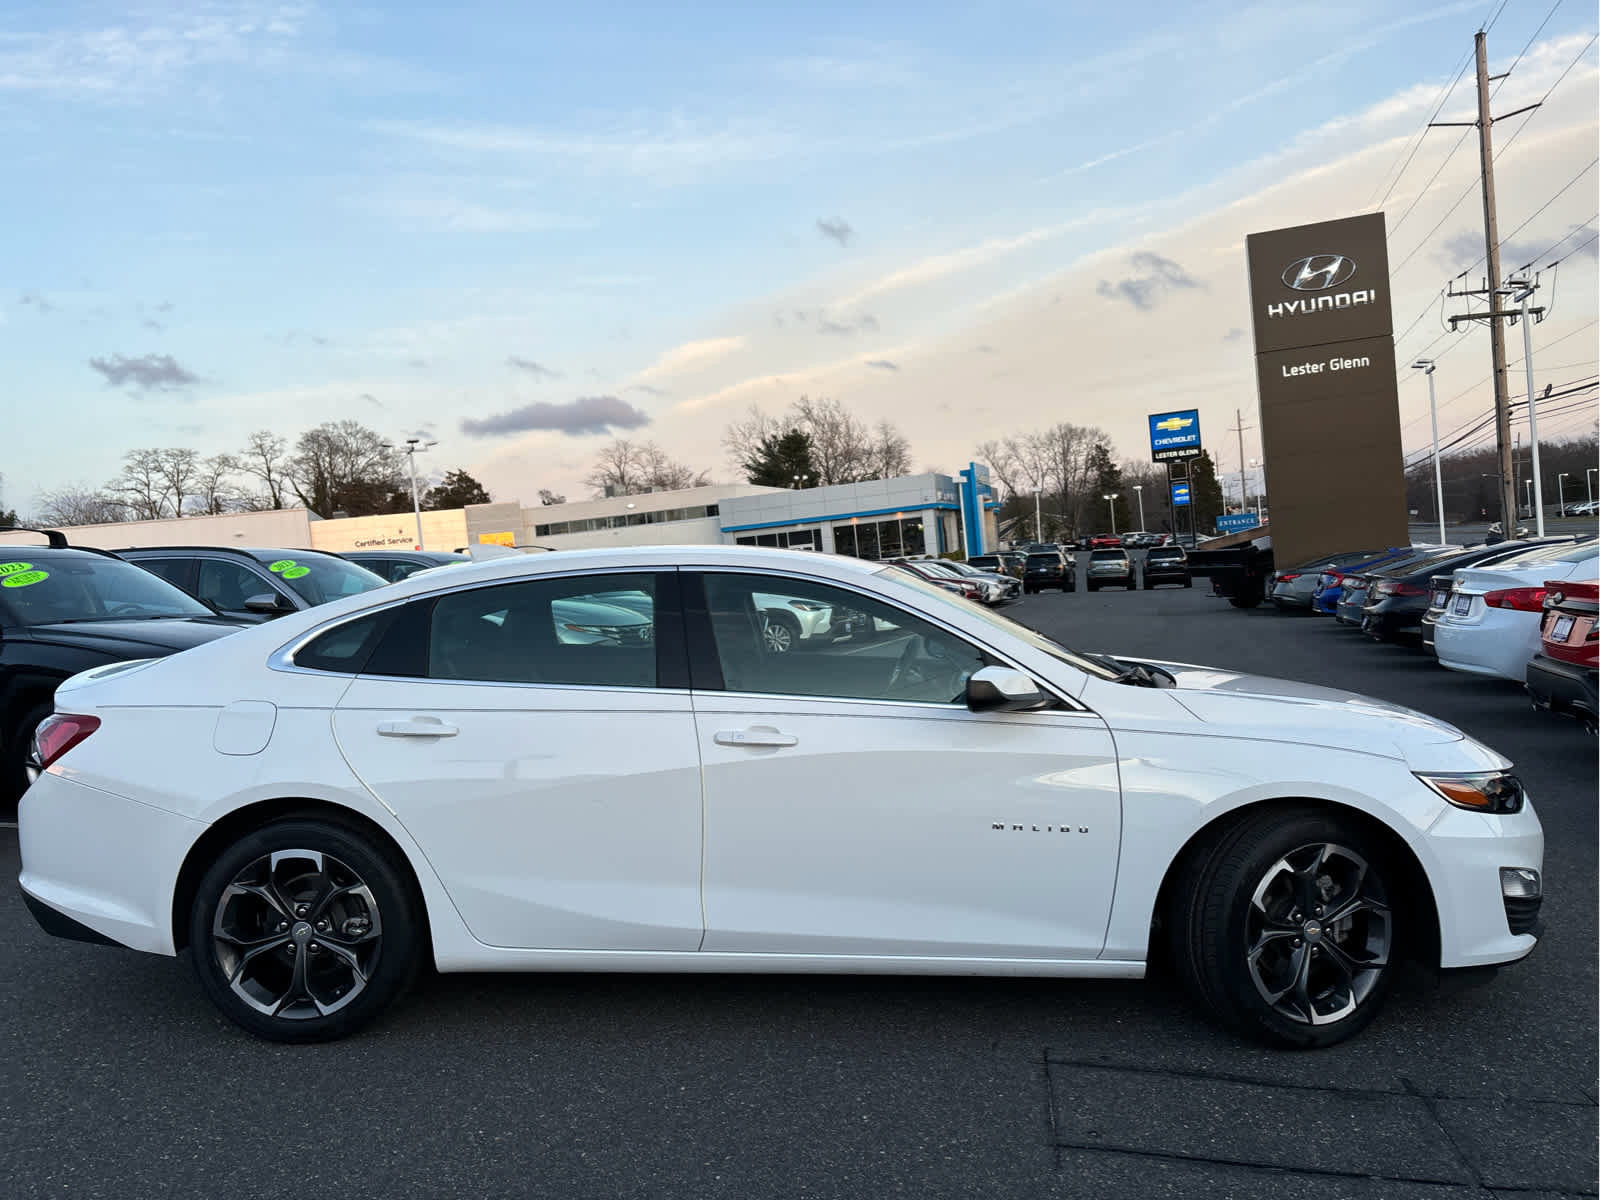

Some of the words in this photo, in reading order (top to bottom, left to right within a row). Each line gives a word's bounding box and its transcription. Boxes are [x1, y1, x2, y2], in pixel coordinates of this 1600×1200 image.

[1267, 289, 1375, 317] HYUNDAI
[1282, 361, 1326, 377] Lester
[1329, 356, 1370, 371] Glenn
[1154, 434, 1196, 446] CHEVROLET
[1155, 450, 1178, 459] LESTER
[1179, 448, 1199, 457] GLENN
[1219, 517, 1255, 527] ENTRANCE
[354, 536, 385, 548] Certified
[387, 536, 413, 545] Service
[991, 822, 1089, 833] MALIBU
